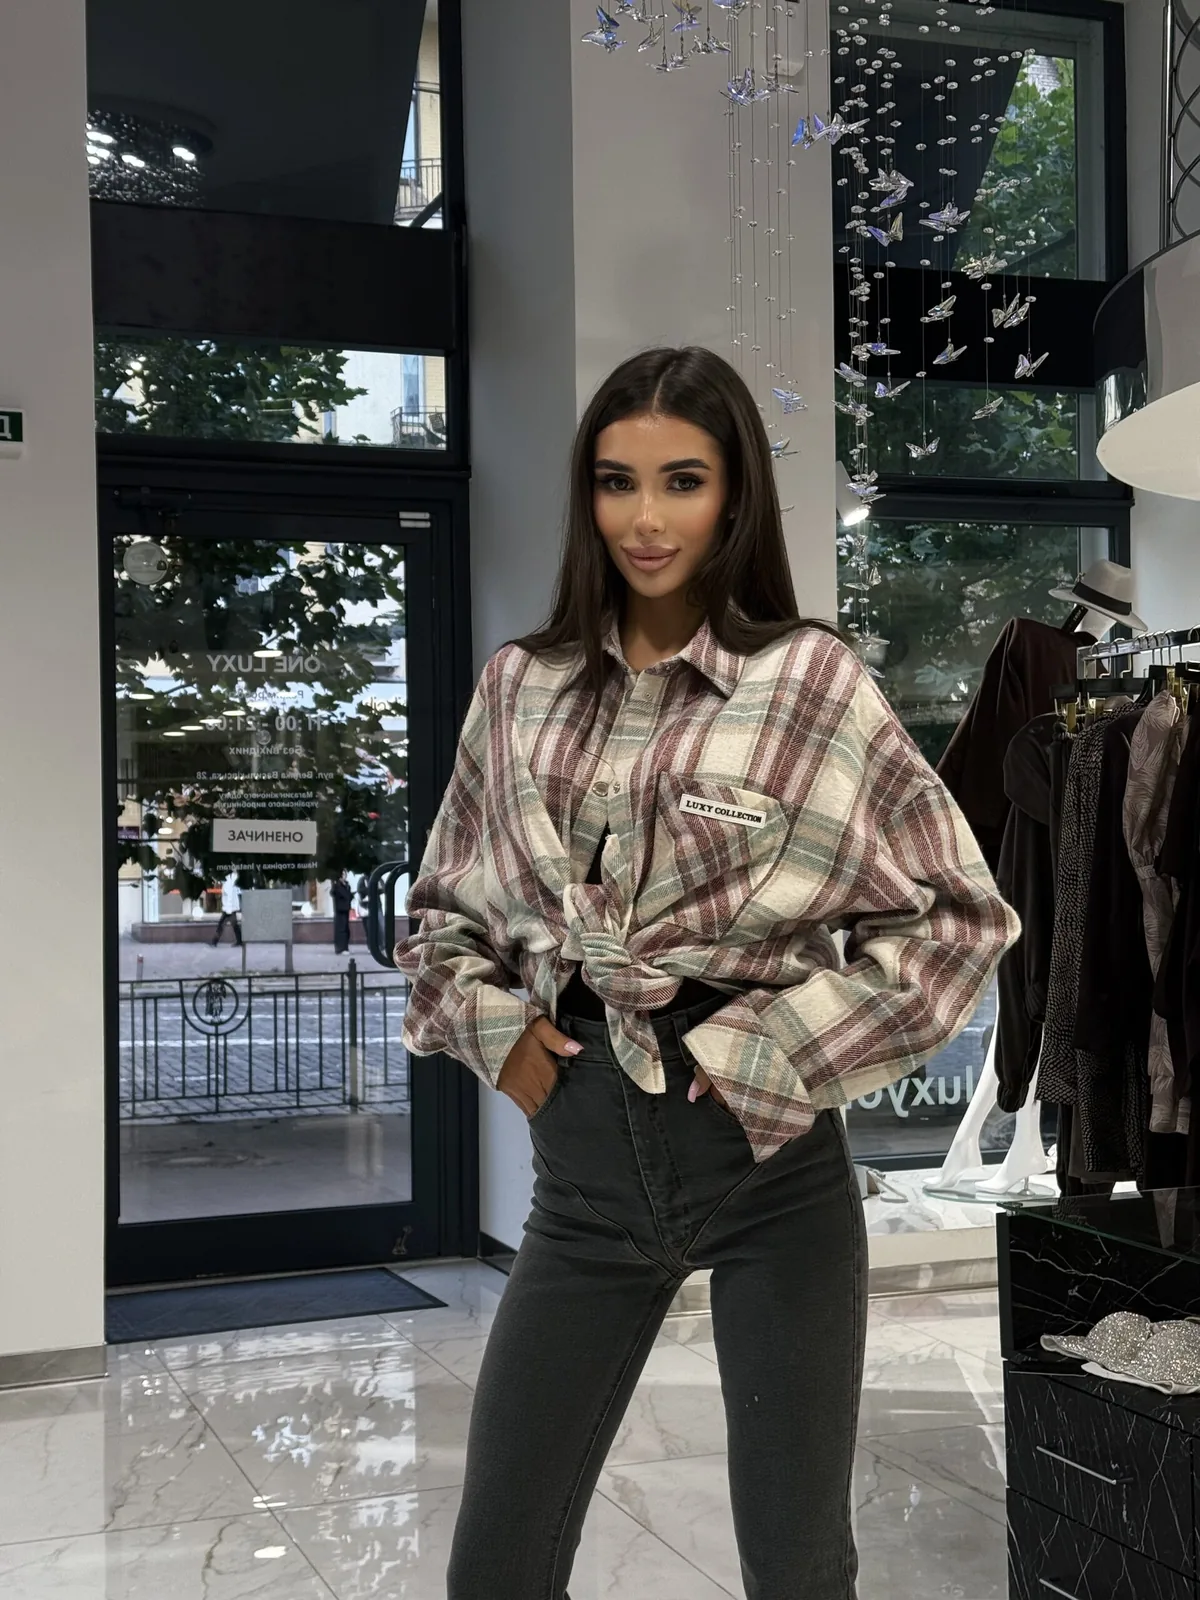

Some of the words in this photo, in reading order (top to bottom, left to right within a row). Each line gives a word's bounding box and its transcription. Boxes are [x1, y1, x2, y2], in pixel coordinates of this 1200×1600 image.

[685, 800, 714, 813] LUXY
[714, 806, 763, 824] COLLECTION
[227, 829, 304, 843] ЗАЧИНЕНО
